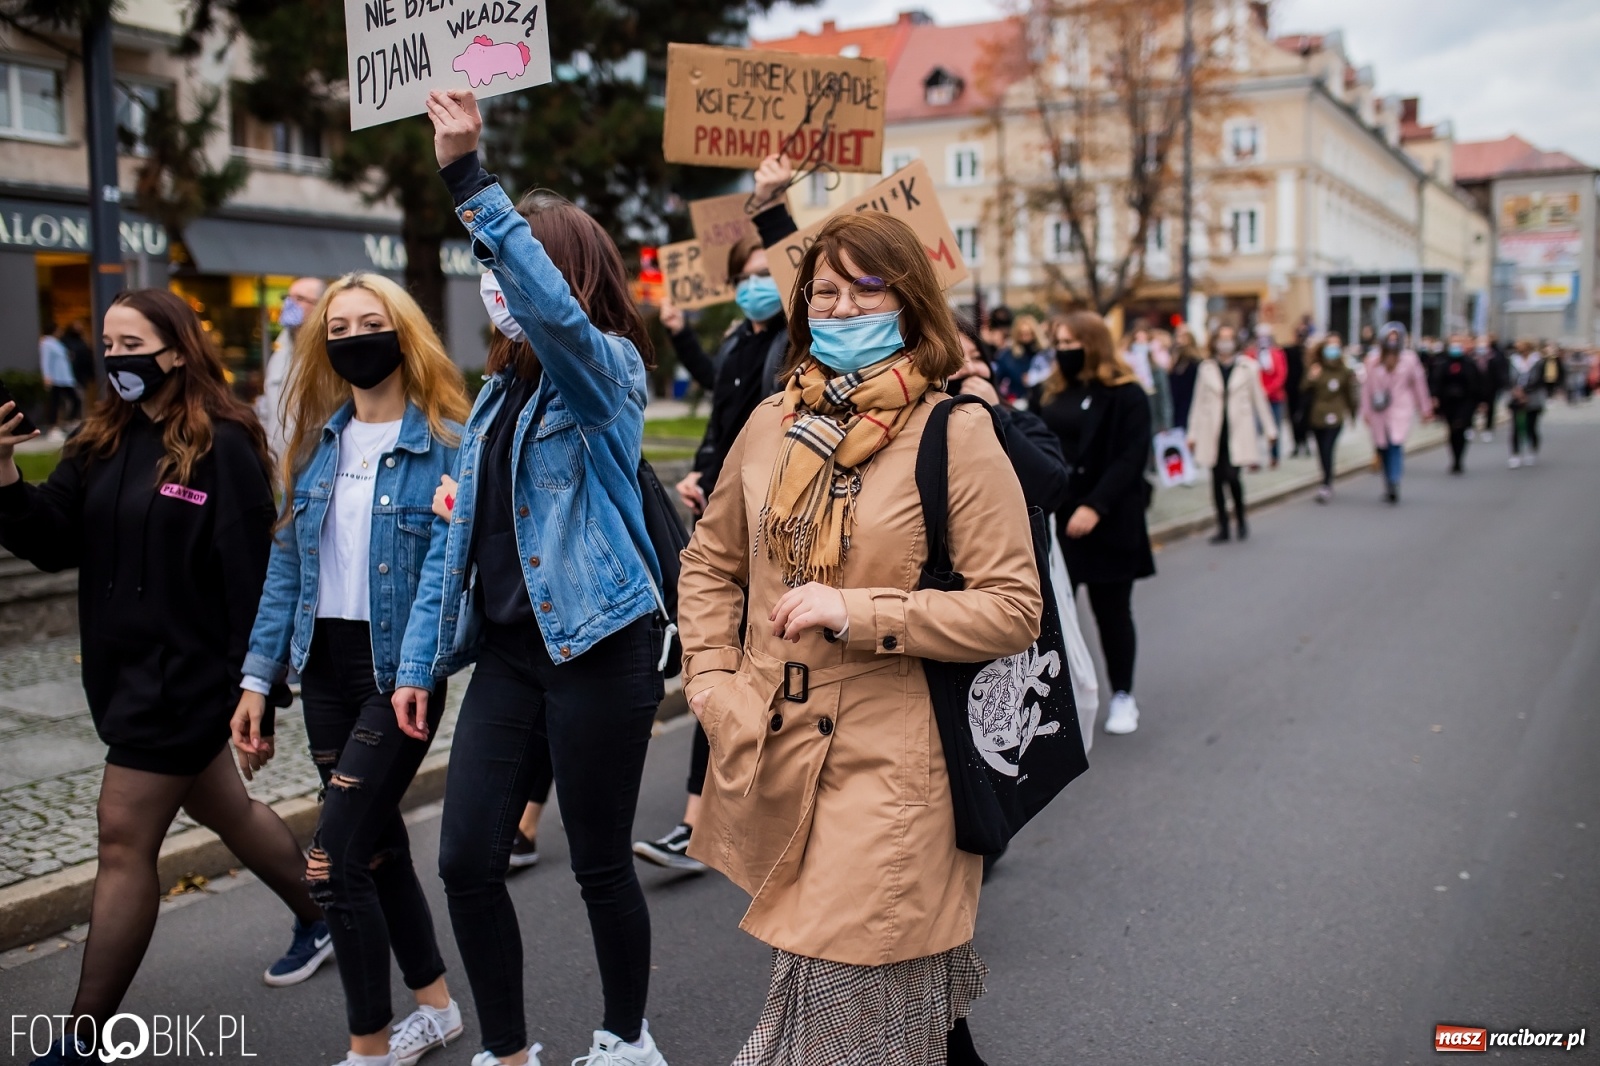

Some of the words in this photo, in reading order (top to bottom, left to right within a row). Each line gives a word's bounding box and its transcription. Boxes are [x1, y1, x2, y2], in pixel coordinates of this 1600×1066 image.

[365, 0, 397, 32] NIE
[446, 0, 539, 39] WŁADZĄ
[357, 32, 432, 110] PIJANA
[725, 58, 797, 96] JAREK
[695, 87, 786, 122] KSIĘŻYC
[694, 125, 771, 157] PRAWA
[778, 125, 875, 168] KOBIET
[118, 220, 168, 256] NU
[163, 485, 205, 502] PLAYBOY
